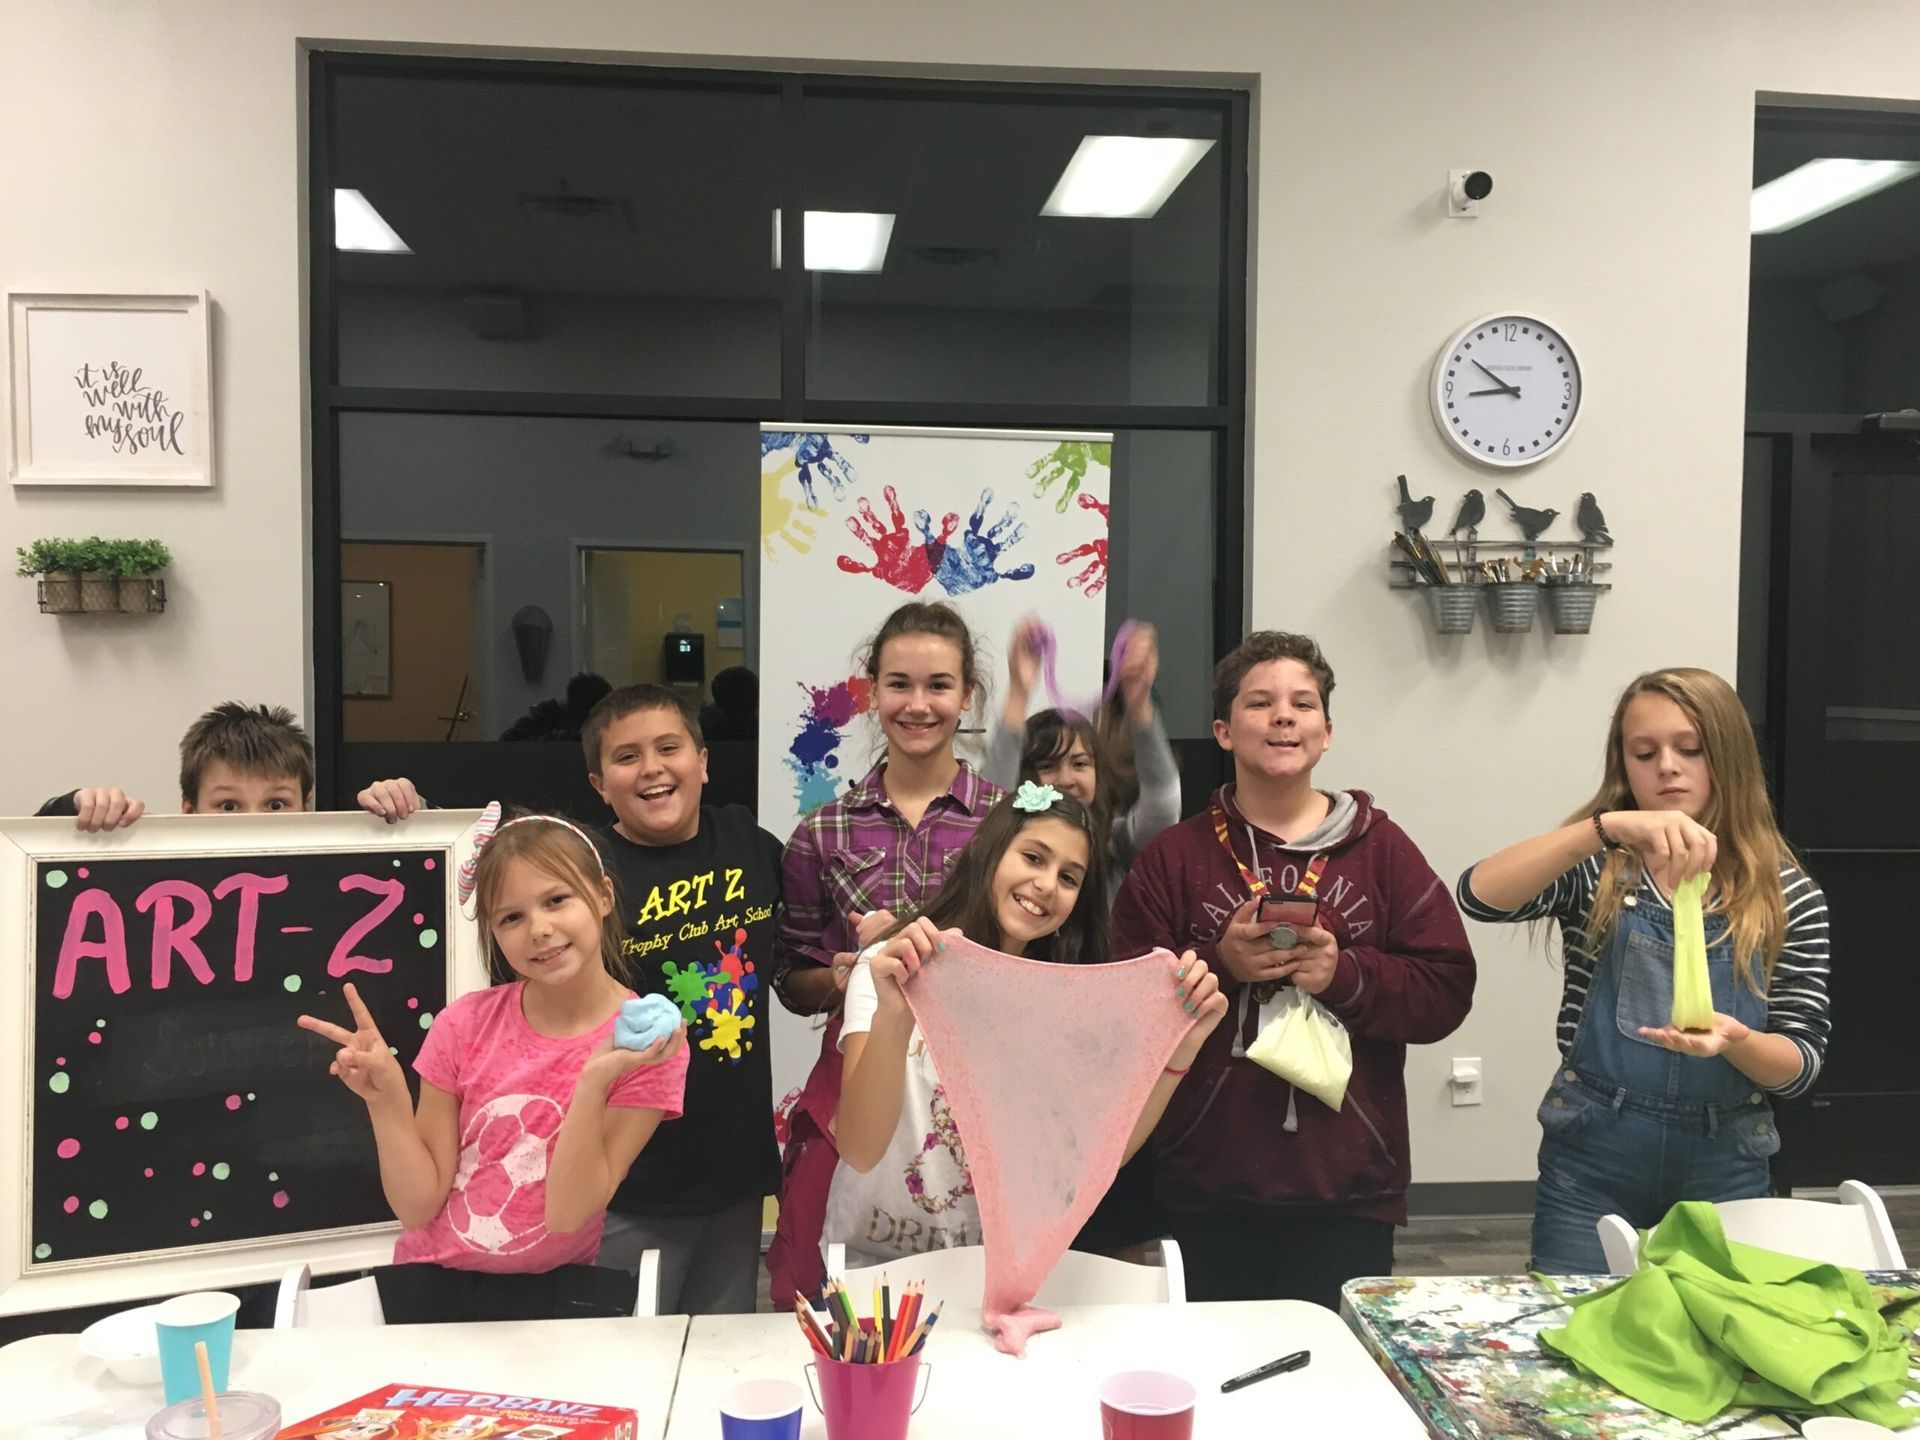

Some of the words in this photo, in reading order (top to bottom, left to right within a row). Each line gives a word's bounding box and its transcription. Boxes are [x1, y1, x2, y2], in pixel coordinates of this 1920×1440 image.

[1503, 323, 1518, 342] 12
[74, 363, 100, 389] it
[102, 361, 127, 381] is
[83, 367, 152, 407] well
[1445, 381, 1454, 399] 9
[112, 391, 171, 423] with
[1563, 382, 1572, 401] 3
[84, 414, 123, 444] my
[112, 411, 185, 455] soul
[1502, 437, 1511, 456] 6
[636, 870, 715, 926] ART
[725, 867, 746, 903] Z
[1189, 863, 1375, 942] CALFONIA
[620, 933, 674, 958] Trophy
[678, 920, 709, 942] Club
[713, 913, 740, 932] Art
[866, 1204, 985, 1253] DREA
[385, 1388, 604, 1416] HEDBANZ
